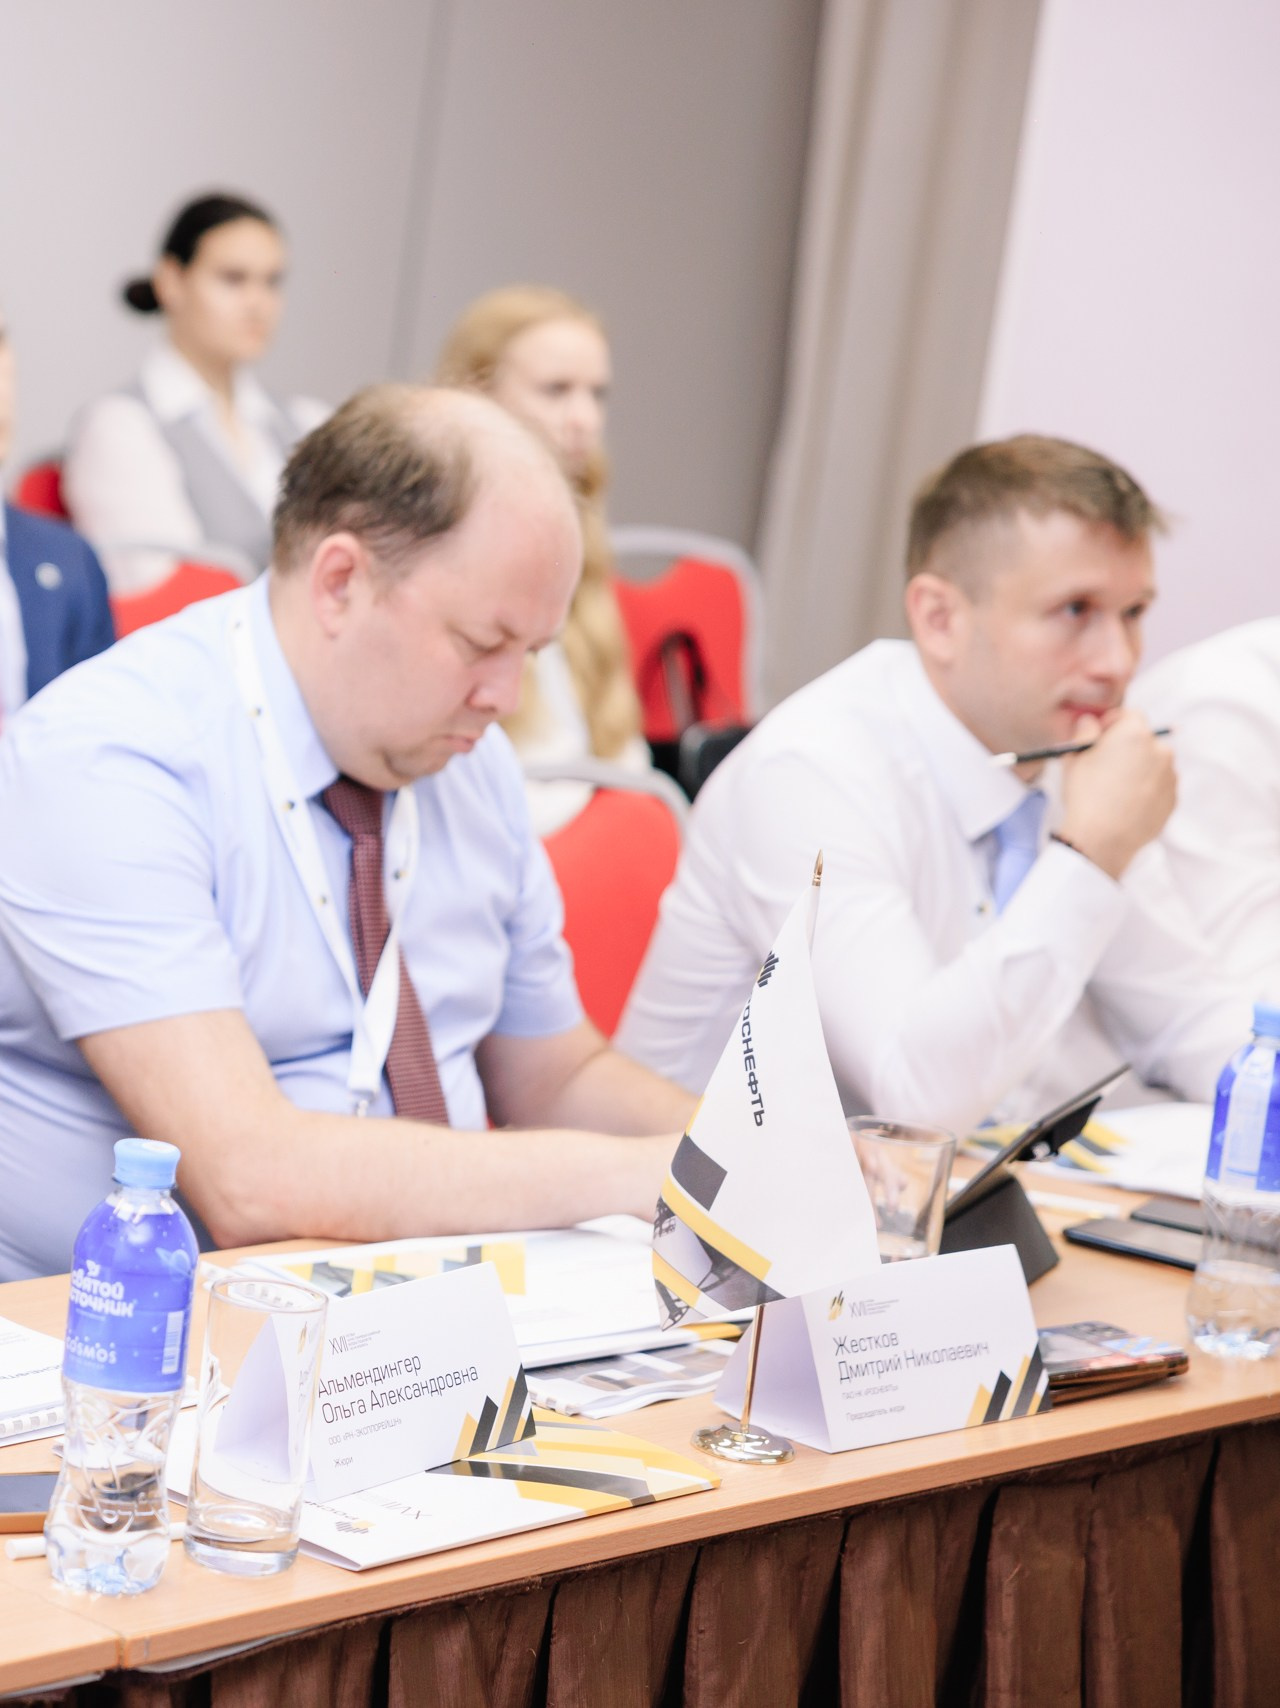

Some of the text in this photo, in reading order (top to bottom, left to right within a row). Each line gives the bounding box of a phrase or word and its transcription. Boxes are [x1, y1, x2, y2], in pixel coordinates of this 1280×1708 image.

[741, 999, 766, 1127] ОСНЕФТЬ
[329, 1335, 349, 1355] XVII
[832, 1332, 899, 1356] Жестков
[318, 1355, 422, 1398] Альмендингер
[838, 1341, 991, 1384] Дмитрий Николаевич
[322, 1366, 479, 1424] Ольга Александровна
[328, 1434, 342, 1446] ООО
[334, 1456, 353, 1467] Жюри
